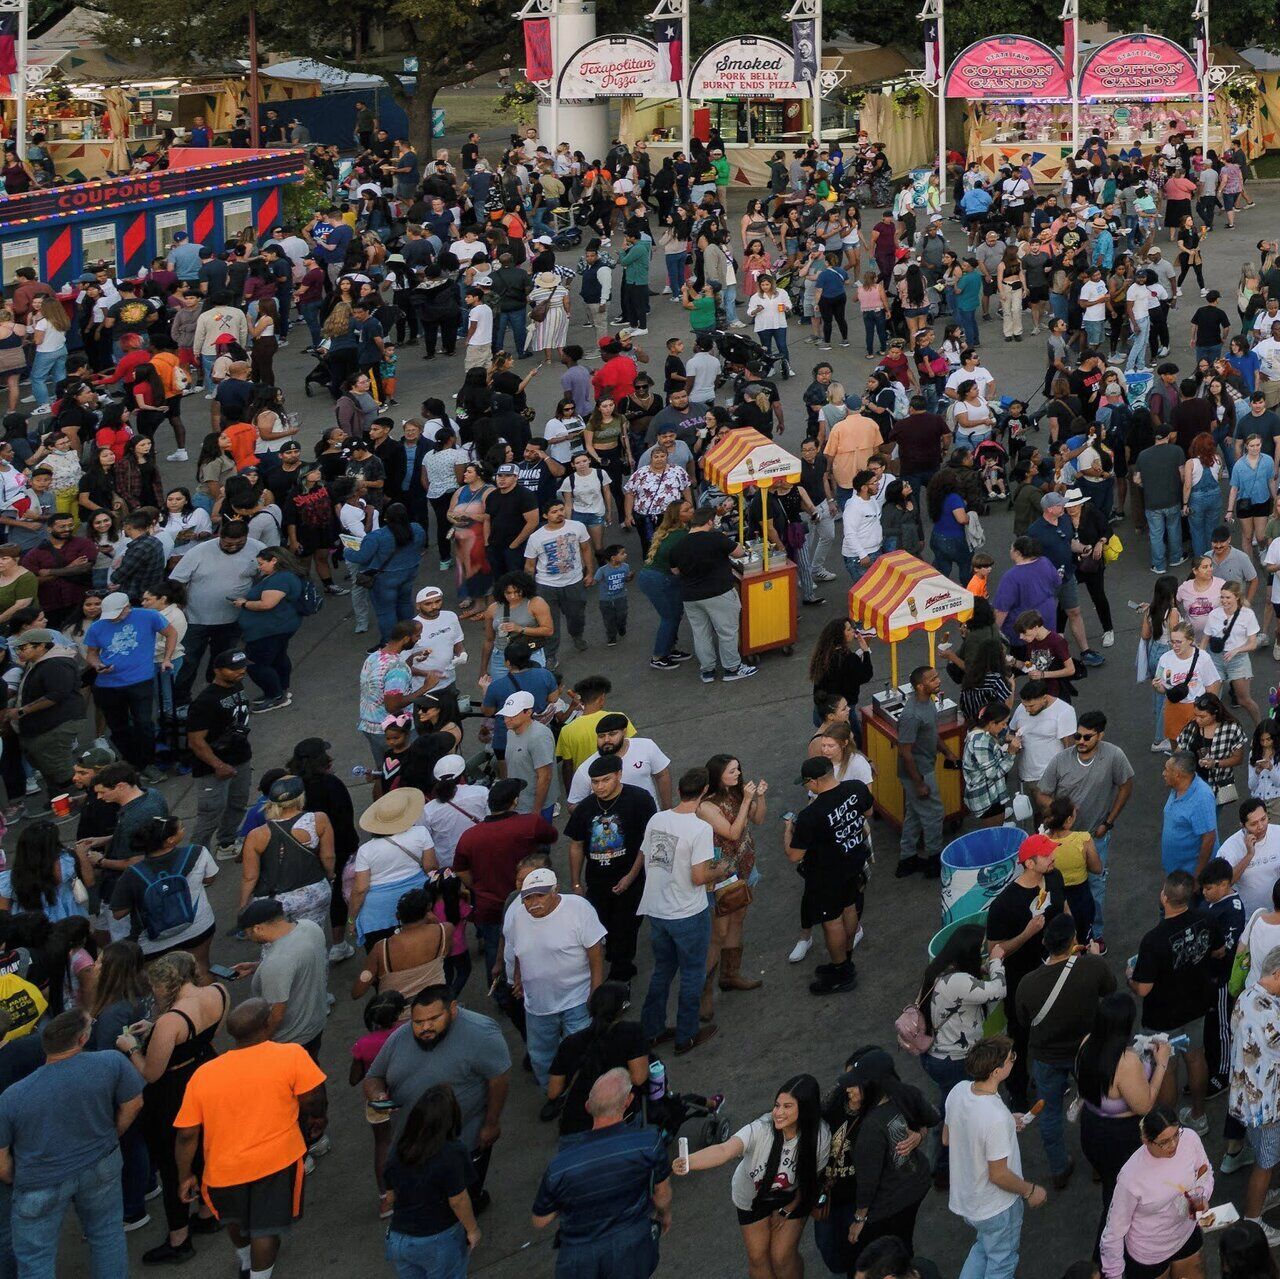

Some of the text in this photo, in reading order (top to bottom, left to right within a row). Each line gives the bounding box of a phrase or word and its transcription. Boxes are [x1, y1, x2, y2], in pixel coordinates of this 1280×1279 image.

[985, 51, 1031, 63] STATE FAIR
[1117, 50, 1161, 61] STATE FAIR
[579, 58, 656, 78] Texapolitan
[716, 55, 784, 74] Smoked
[962, 64, 1054, 77] COTTON
[1094, 63, 1185, 76] COTTON
[601, 75, 639, 89] Pizza
[719, 72, 779, 80] PORK BELLY
[1101, 75, 1178, 88] CANDY
[702, 81, 798, 90] BURNT ENDS PIZZA
[968, 77, 1047, 89] CANDY
[57, 181, 162, 208] COUPONS
[932, 601, 963, 613] CORNY DOGS
[827, 793, 858, 826] Here
[844, 809, 858, 822] to
[841, 835, 864, 853] you
